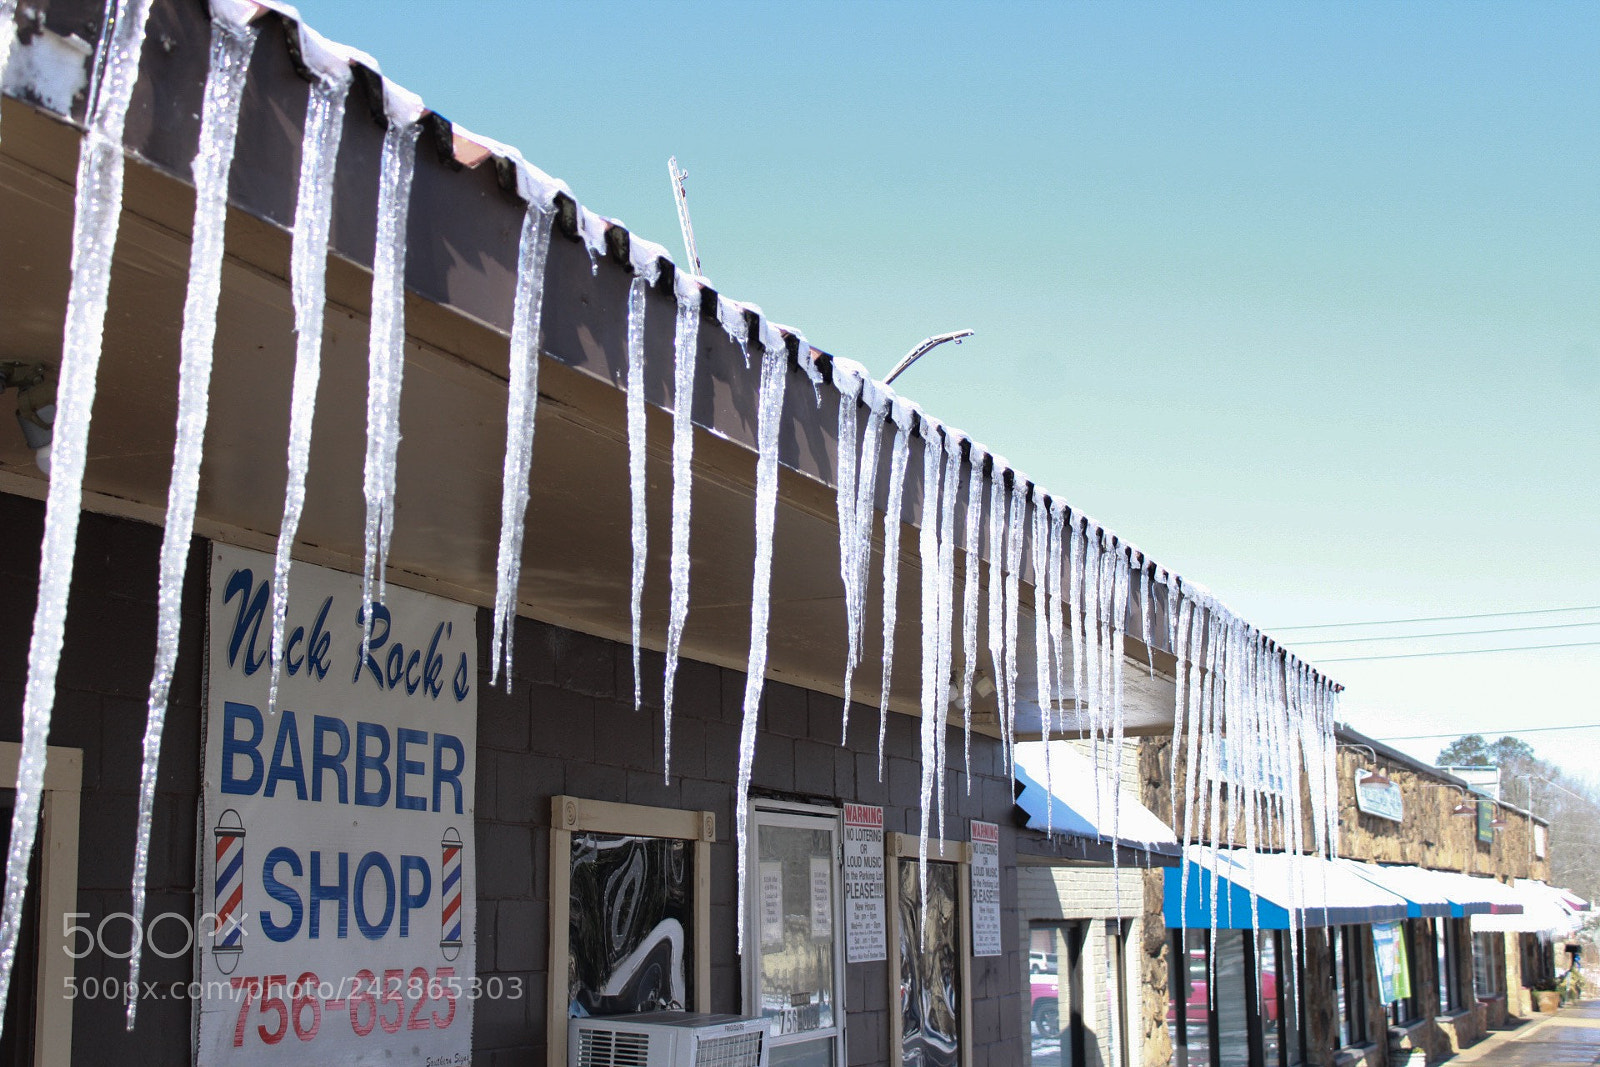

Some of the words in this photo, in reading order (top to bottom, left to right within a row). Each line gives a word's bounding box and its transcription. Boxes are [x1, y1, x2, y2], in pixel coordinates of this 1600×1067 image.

[352, 601, 470, 702] Rock's
[221, 701, 465, 814] BARBER
[845, 804, 882, 824] WARNING
[846, 828, 854, 841] NO
[856, 828, 881, 842] LOITERING
[971, 821, 998, 840] WARNING
[860, 843, 868, 855] OR
[847, 856, 862, 868] LOUD
[864, 856, 882, 869] MUSIC
[859, 871, 875, 882] Parking
[259, 846, 432, 943] SHOP
[230, 967, 456, 1048] 756-6525
